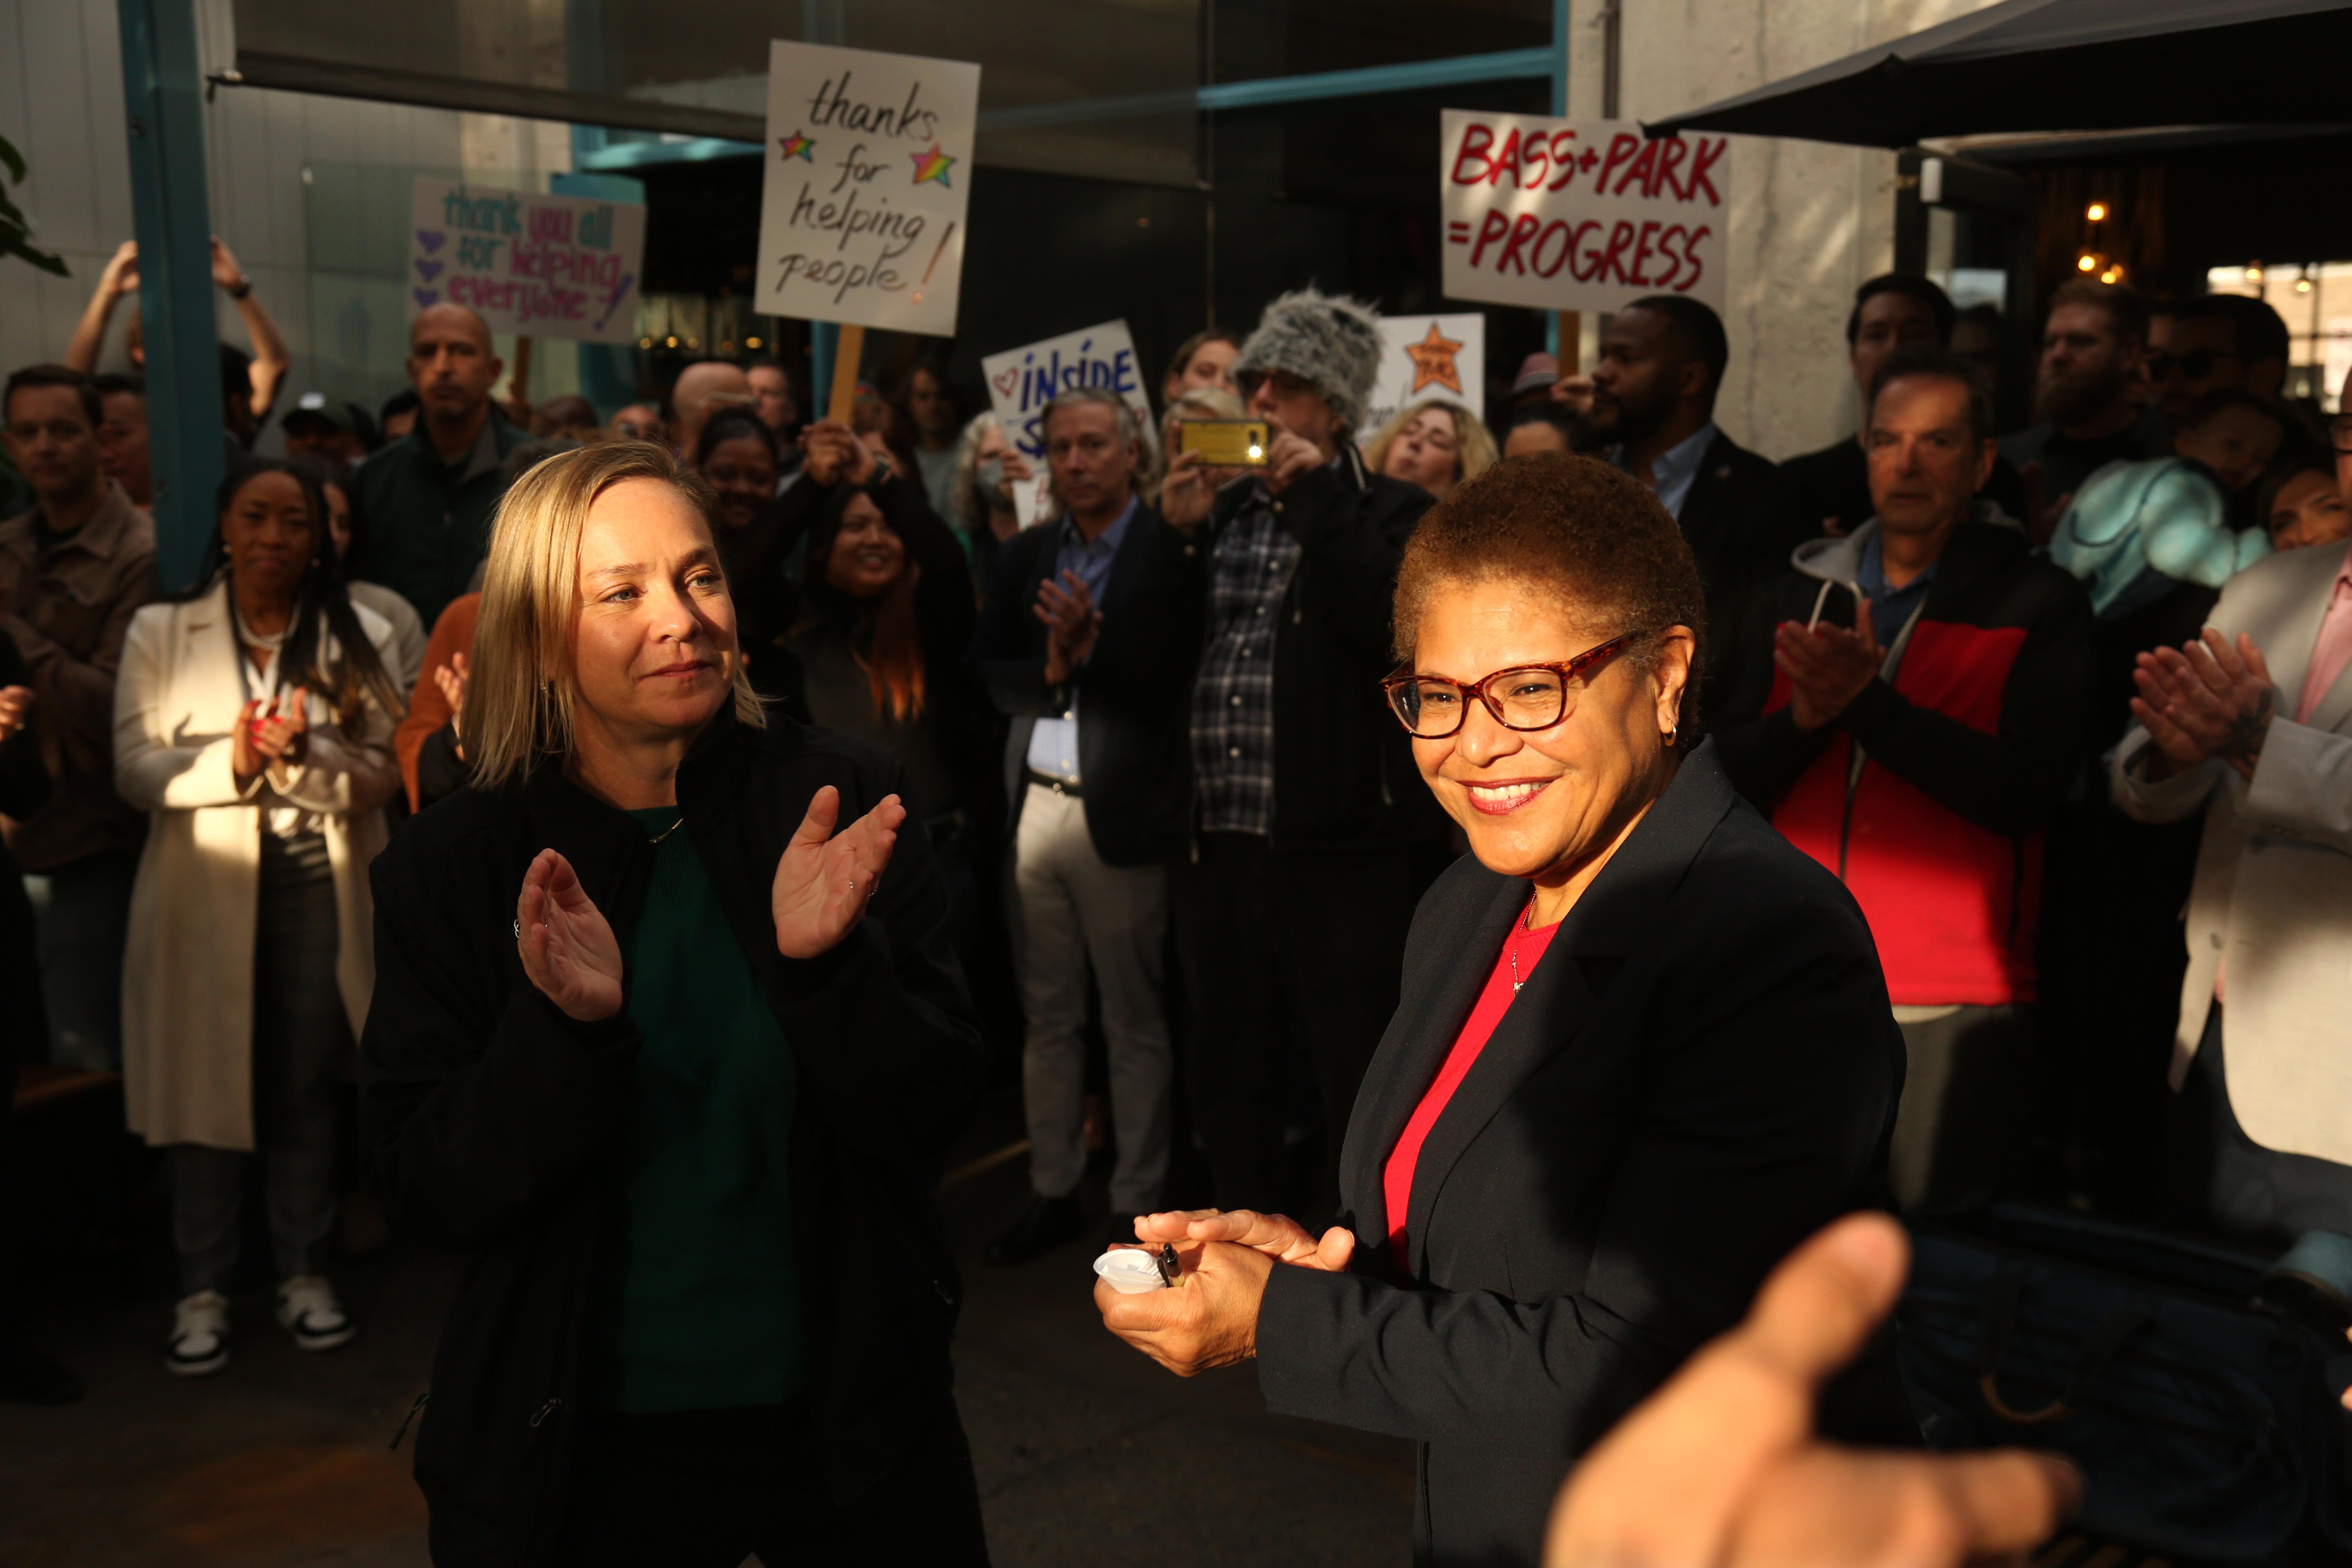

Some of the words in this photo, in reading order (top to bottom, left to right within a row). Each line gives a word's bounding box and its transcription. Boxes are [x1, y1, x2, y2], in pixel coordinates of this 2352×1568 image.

[807, 70, 939, 142] thanks
[831, 142, 891, 194] for
[1451, 123, 1726, 207] BASS+PARK
[443, 184, 523, 235] thank
[528, 205, 573, 246] you
[578, 205, 614, 250] all
[789, 180, 926, 259] helping
[456, 234, 506, 271] for
[510, 236, 622, 304] helping
